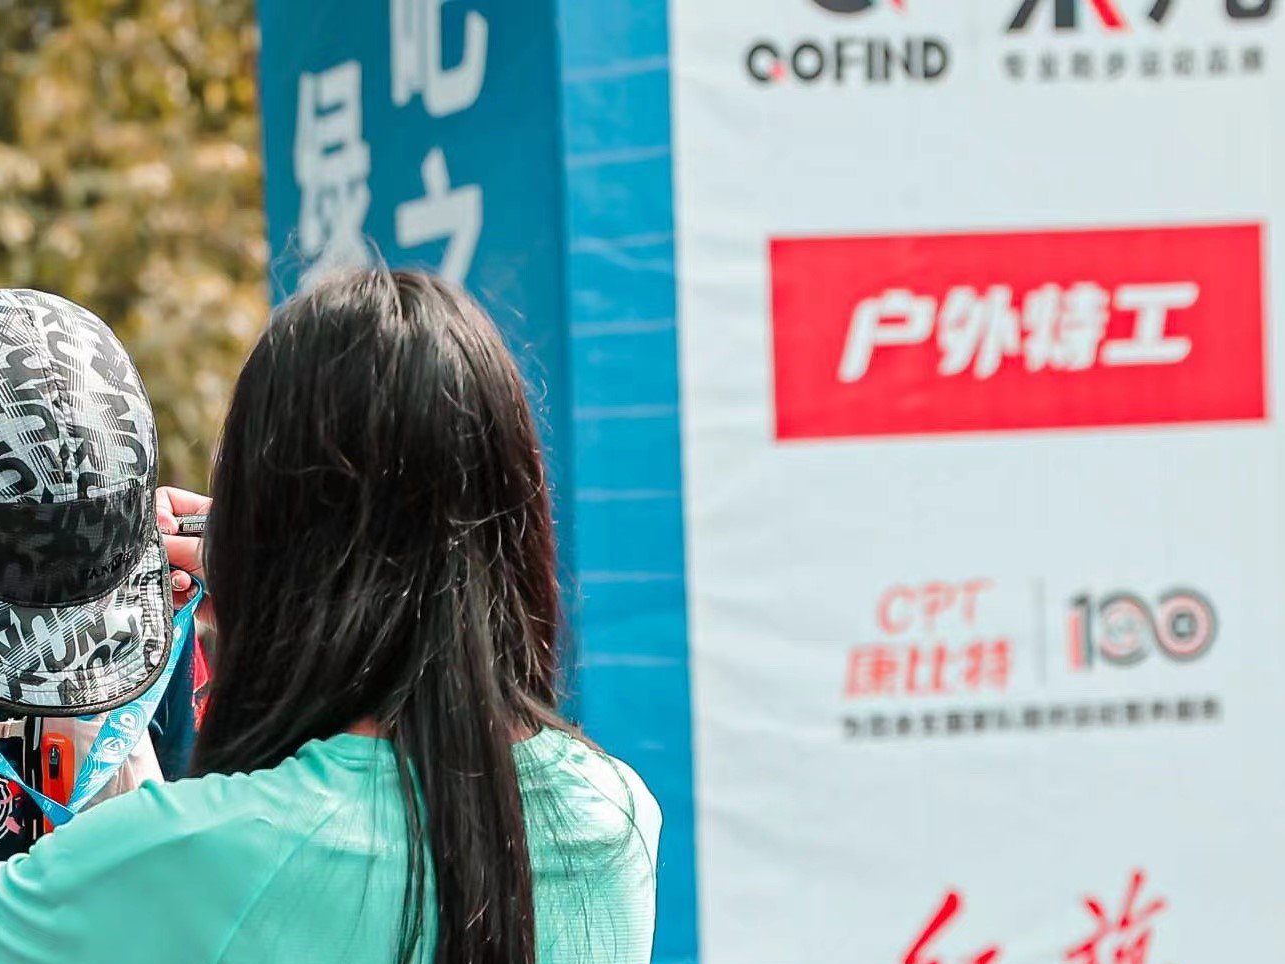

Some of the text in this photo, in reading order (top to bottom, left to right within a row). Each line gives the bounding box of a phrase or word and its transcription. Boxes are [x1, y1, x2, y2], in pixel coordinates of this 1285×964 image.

[837, 280, 1200, 384] 户外特工
[875, 577, 994, 636] CPT
